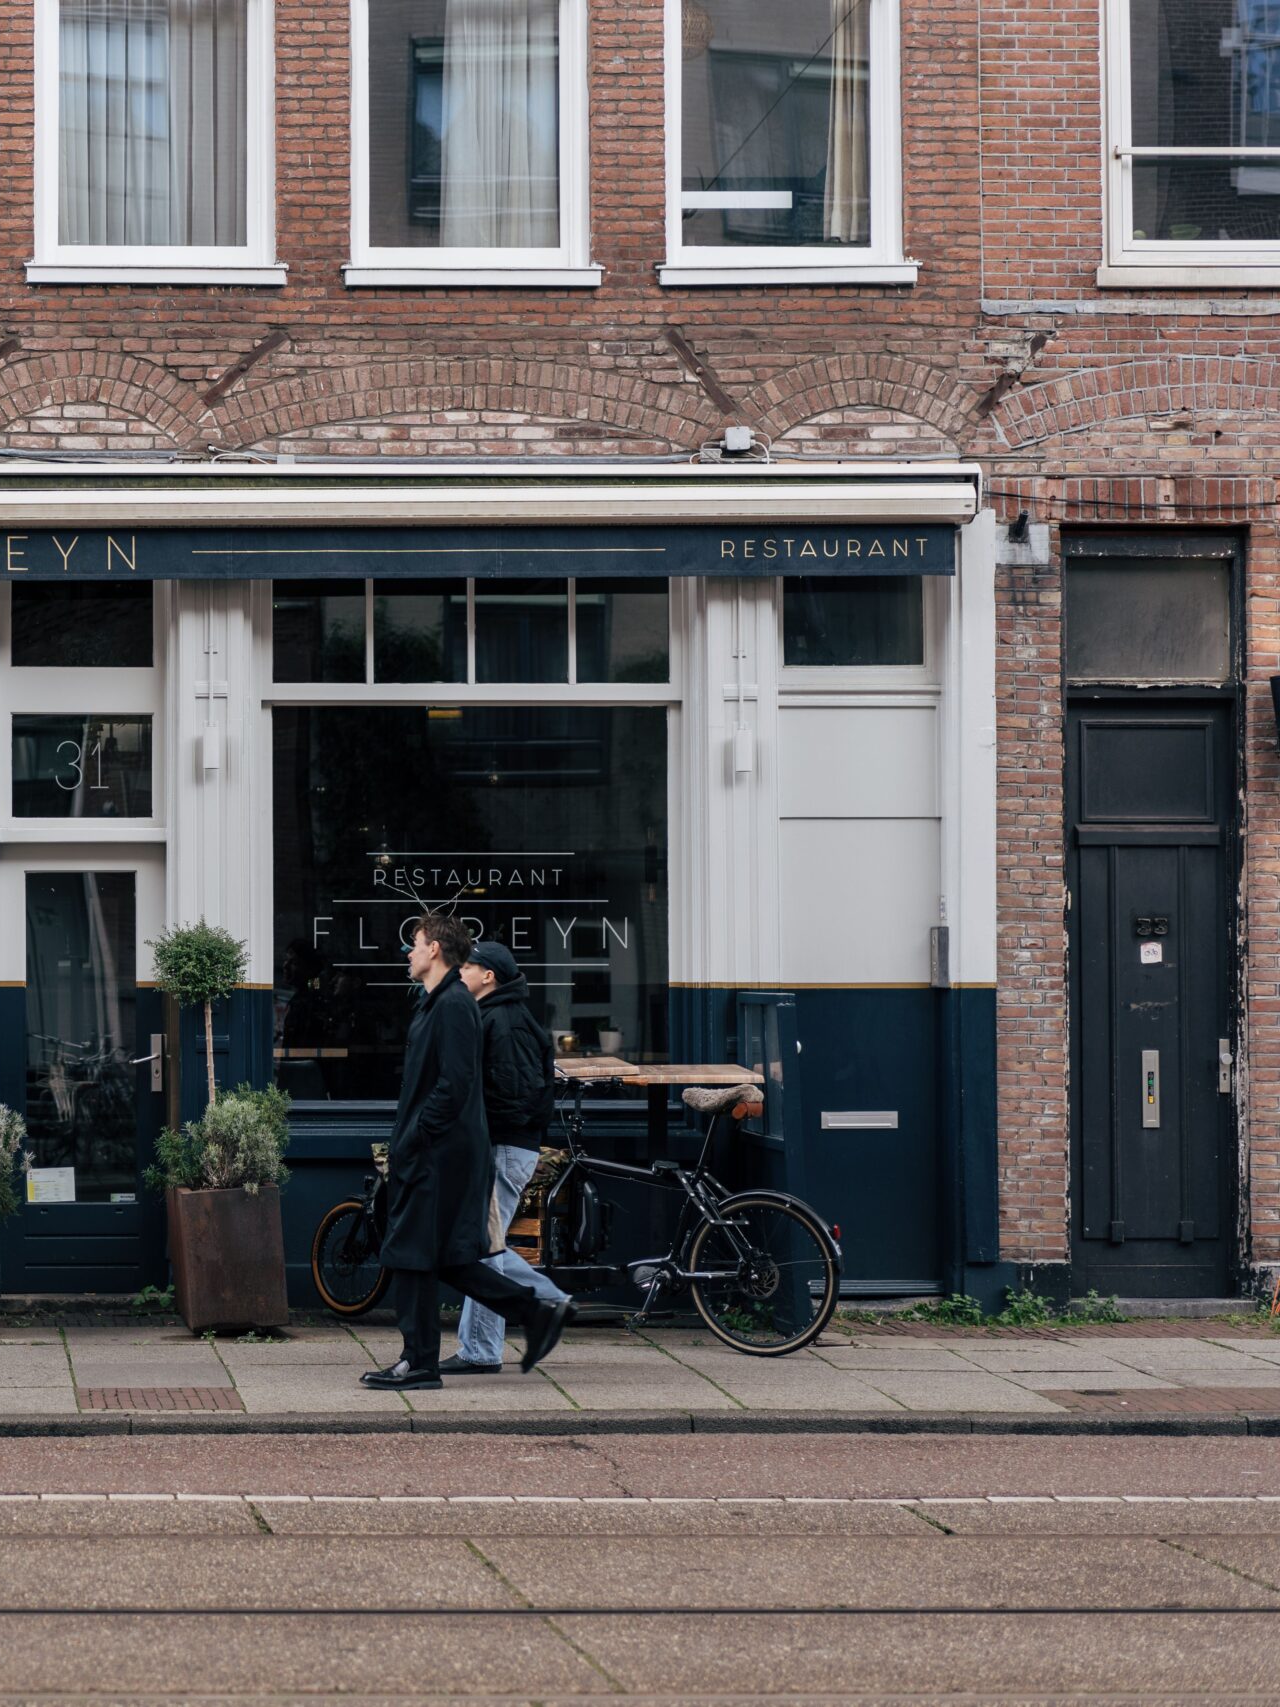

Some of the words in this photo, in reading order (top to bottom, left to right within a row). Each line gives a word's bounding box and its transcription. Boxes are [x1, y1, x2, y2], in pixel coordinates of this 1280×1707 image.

[720, 537, 929, 559] RESTAURANT
[55, 740, 110, 790] 31
[373, 868, 564, 887] RESTAURANT
